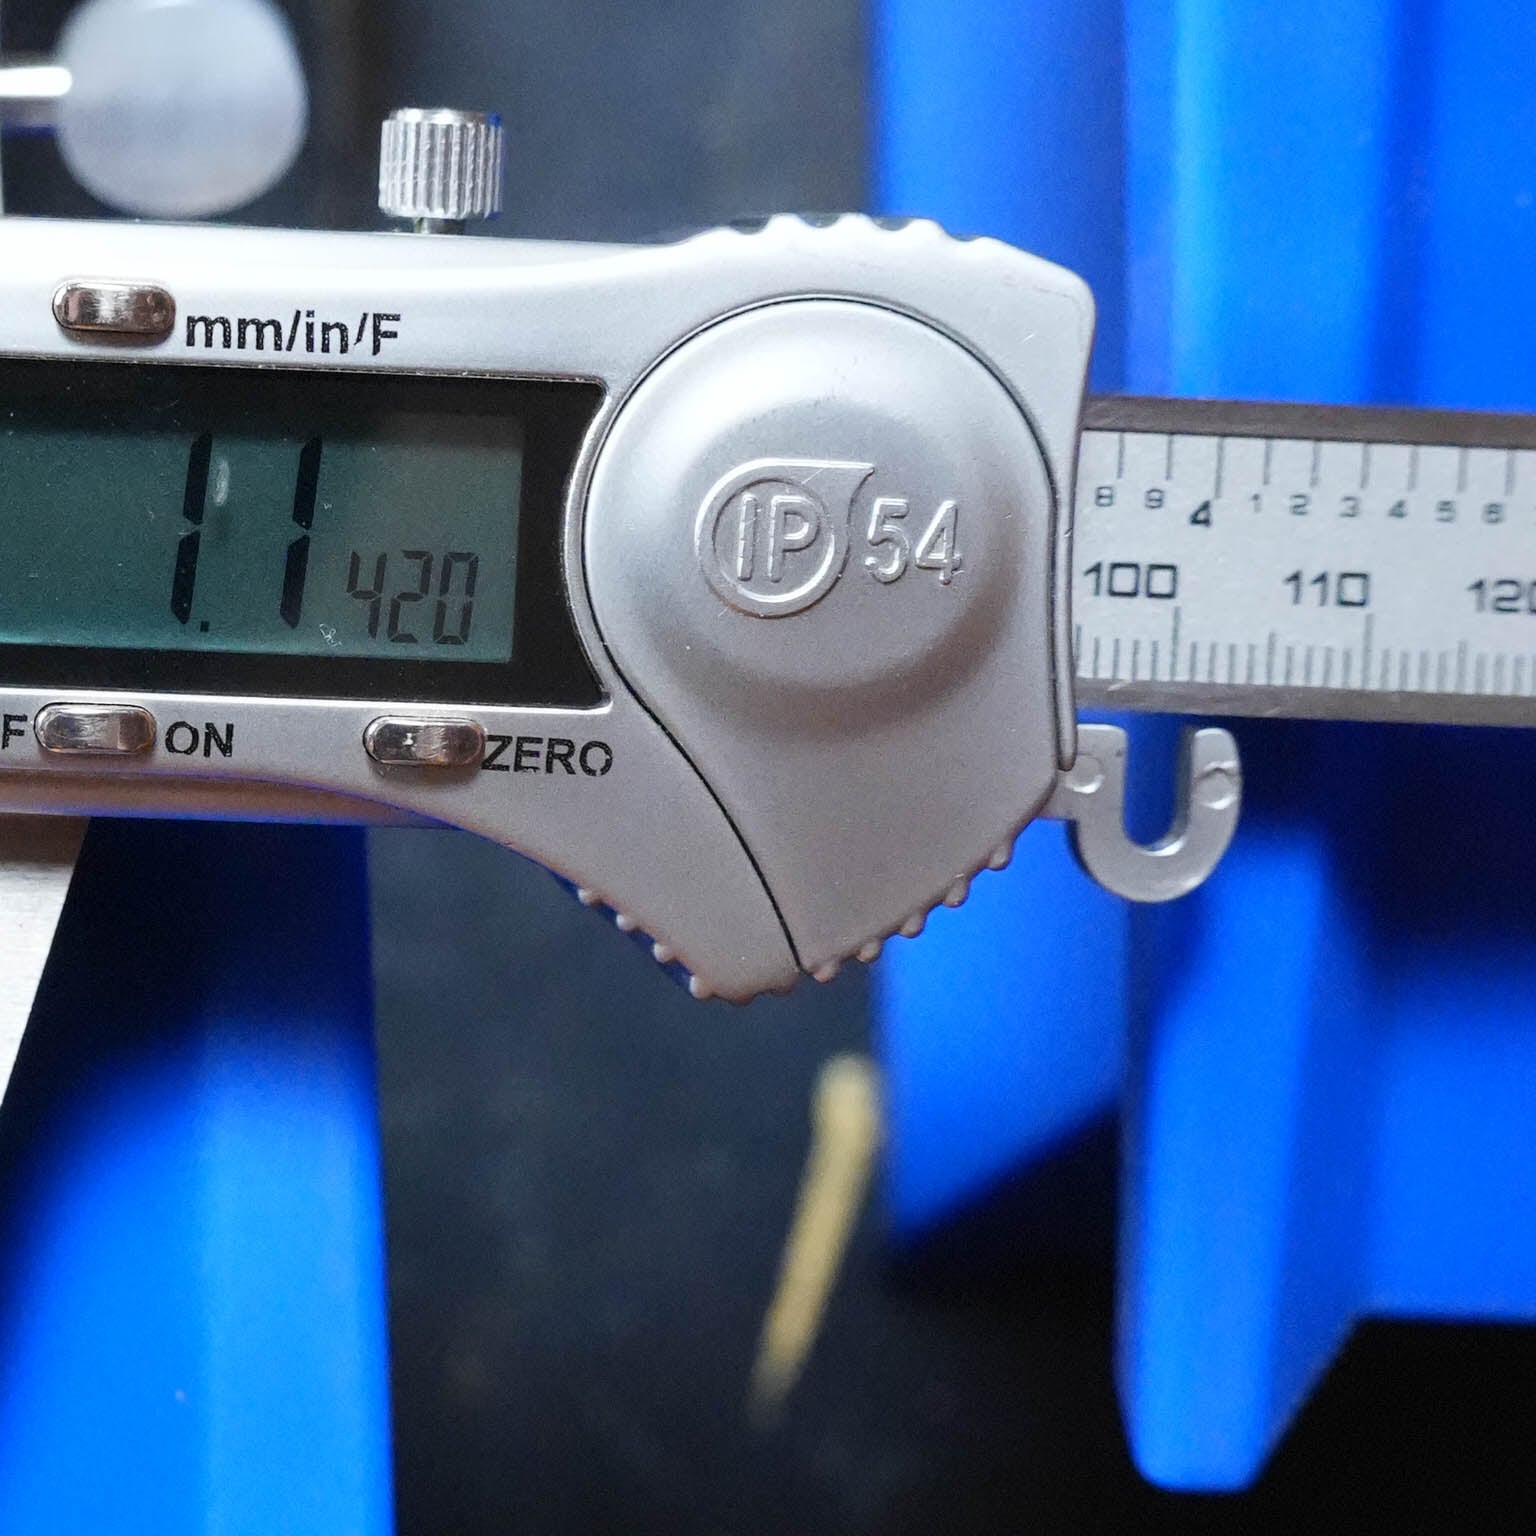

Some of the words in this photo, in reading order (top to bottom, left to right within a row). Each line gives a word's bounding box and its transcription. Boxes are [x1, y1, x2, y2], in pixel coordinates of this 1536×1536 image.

[184, 307, 401, 358] mm/in/F
[1094, 485, 1114, 508] 8
[1144, 487, 1166, 510] 9
[1189, 500, 1212, 527] 4
[1251, 492, 1264, 514] 1
[1289, 493, 1310, 516] 2
[1339, 495, 1361, 518] 3
[1388, 499, 1409, 519] 4
[735, 493, 822, 583] IP
[864, 497, 964, 586] 54
[1083, 561, 1178, 599] 100
[1283, 570, 1370, 608] 110
[1467, 578, 1536, 614] 12
[164, 720, 234, 759] ON
[481, 734, 614, 777] ZERO
